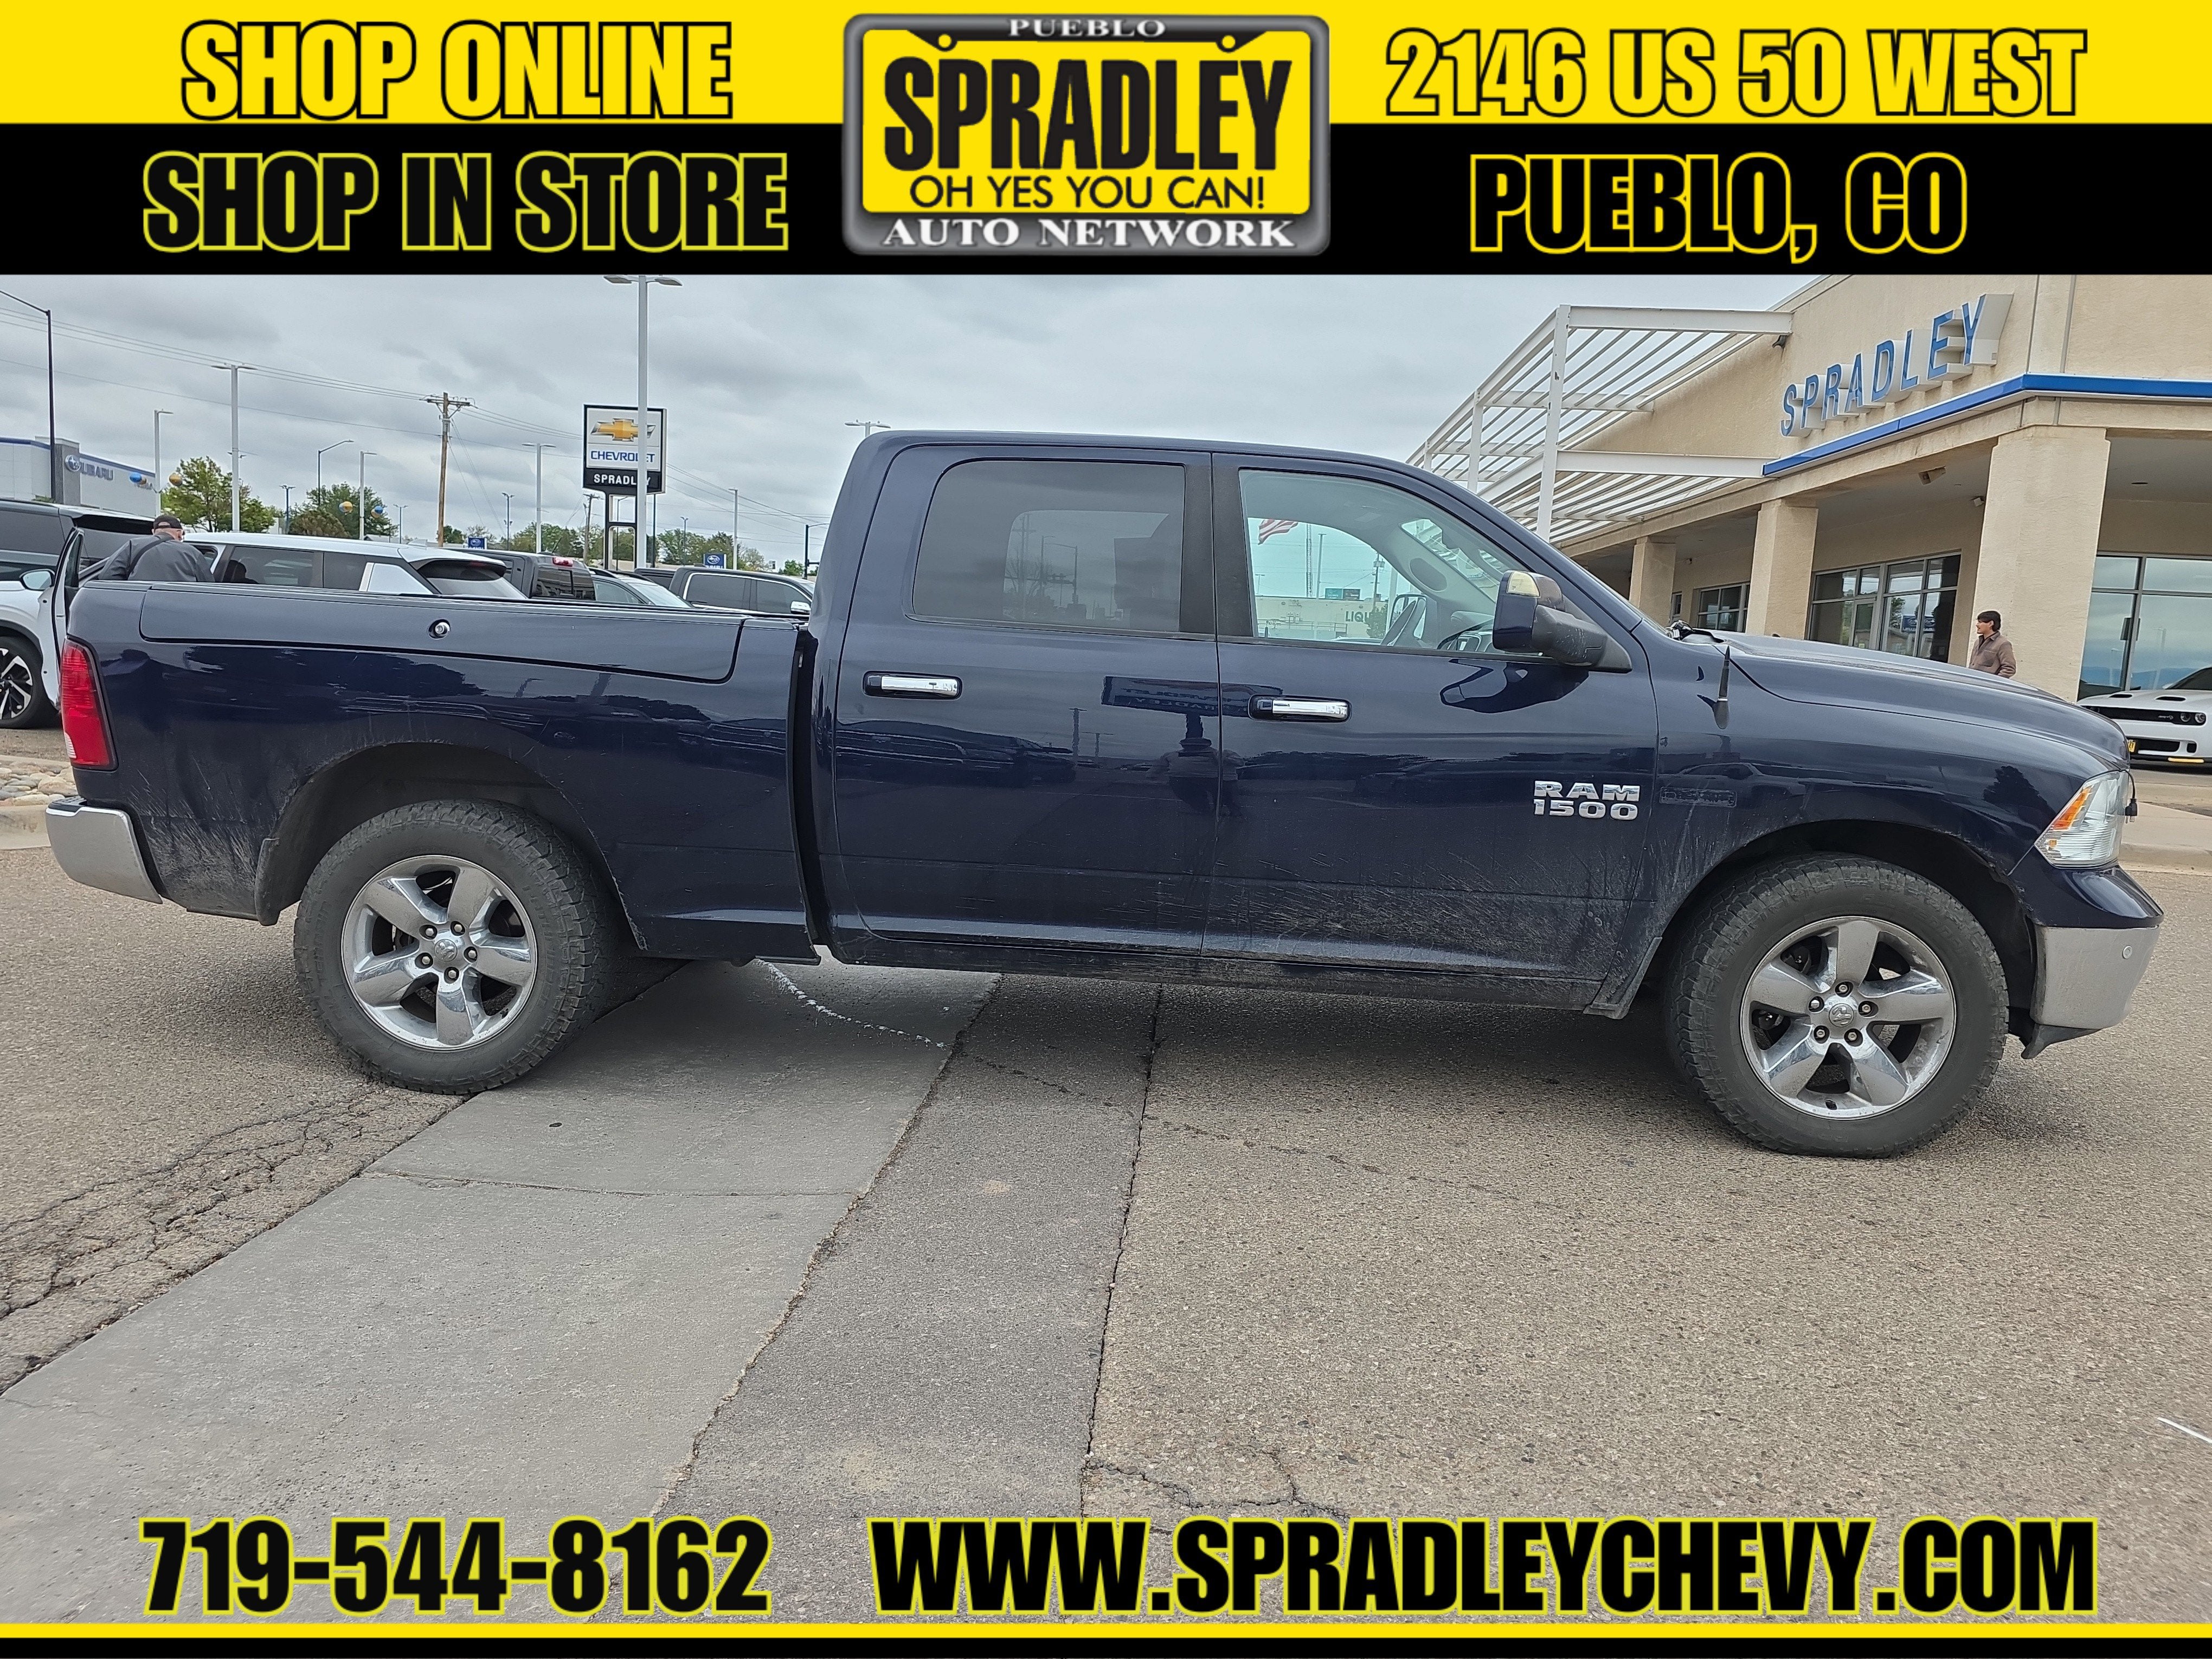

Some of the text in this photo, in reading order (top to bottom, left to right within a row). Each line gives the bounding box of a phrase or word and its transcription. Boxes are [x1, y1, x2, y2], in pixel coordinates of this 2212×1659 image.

[1780, 293, 1986, 438] SPRADLEY
[80, 462, 114, 481] UBARU
[594, 473, 651, 485] SPRADLY
[1534, 780, 1640, 801] RAM
[1533, 799, 1638, 820] 1500
